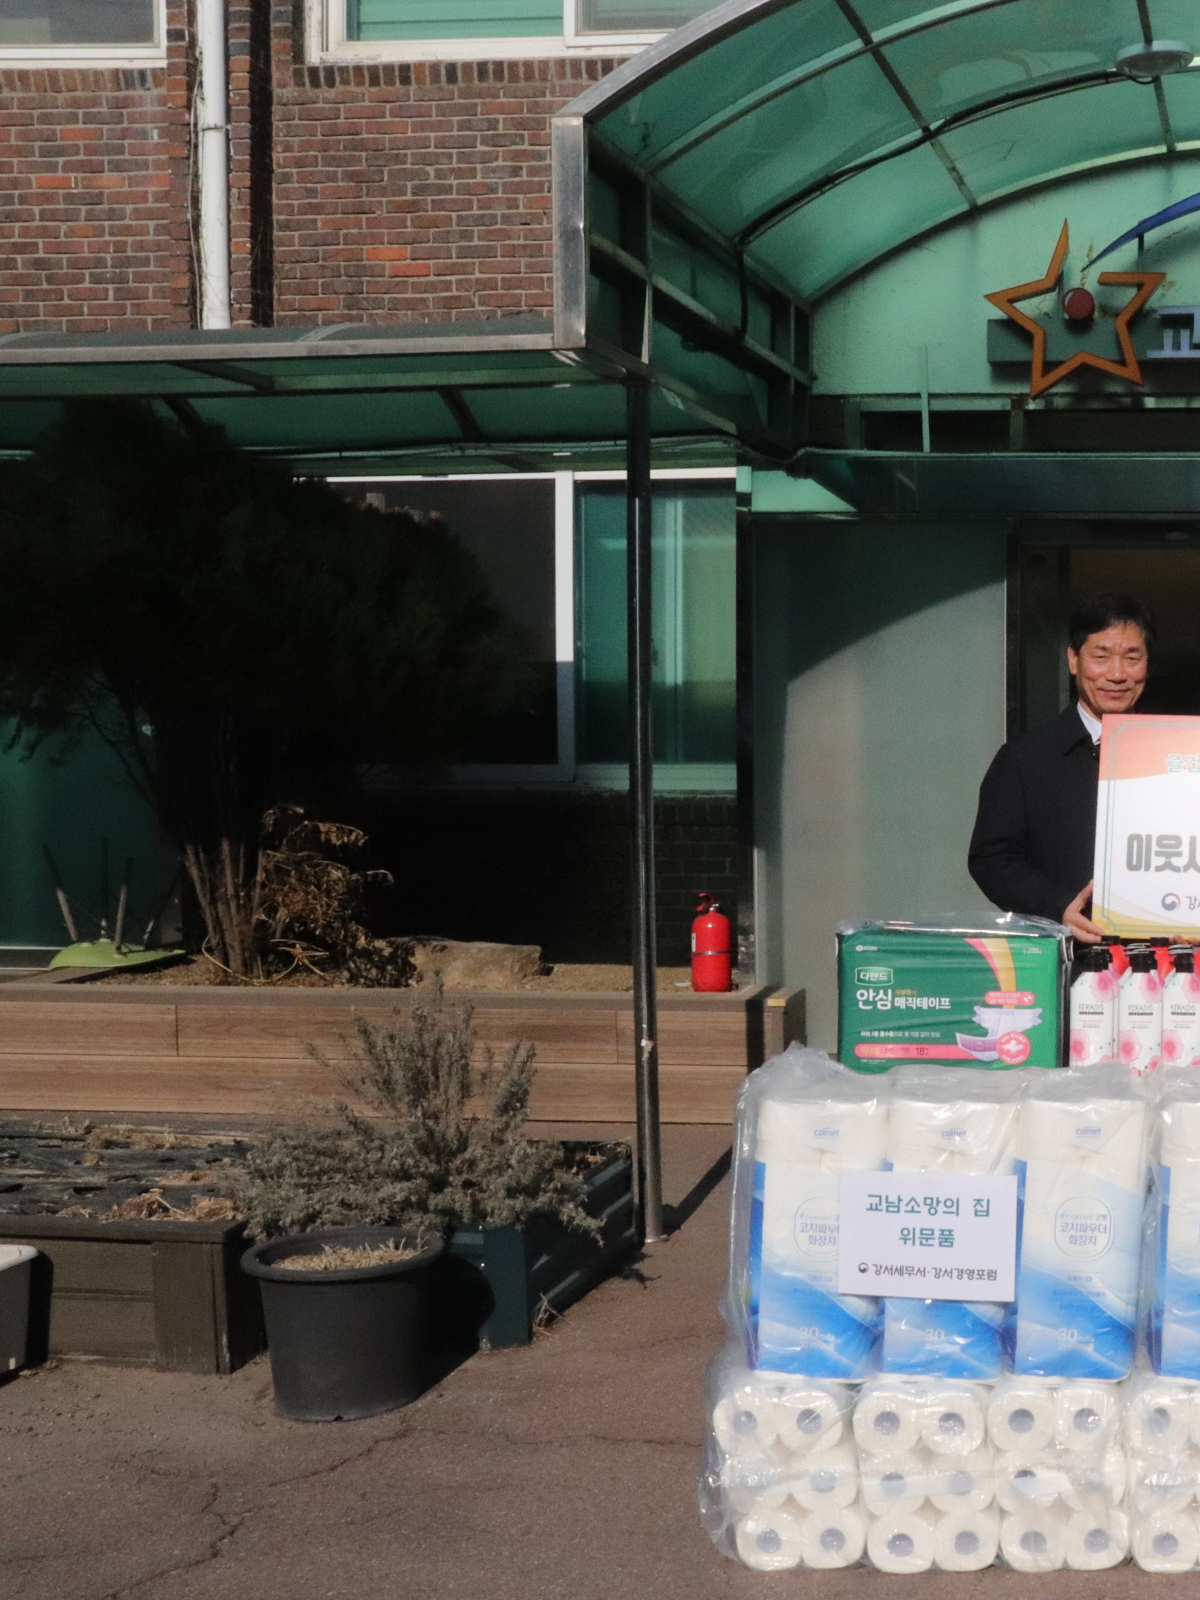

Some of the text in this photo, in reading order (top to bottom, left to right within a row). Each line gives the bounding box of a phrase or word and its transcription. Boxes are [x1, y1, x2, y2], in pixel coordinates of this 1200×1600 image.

[856, 988, 952, 1010] 안심 매직테이프
[1078, 1003, 1105, 1011] KERASYS
[1128, 1004, 1154, 1012] KERASYS
[1170, 1004, 1196, 1012] KERASYS
[814, 1128, 839, 1138] comet
[941, 1129, 967, 1139] comet
[1076, 1126, 1101, 1136] comet
[866, 1194, 990, 1217] 교남소망의 집
[1059, 1222, 1108, 1234] 코지파우더
[808, 1235, 836, 1247] 화장지
[898, 1227, 955, 1248] 위문품
[1068, 1234, 1097, 1246] 화장지
